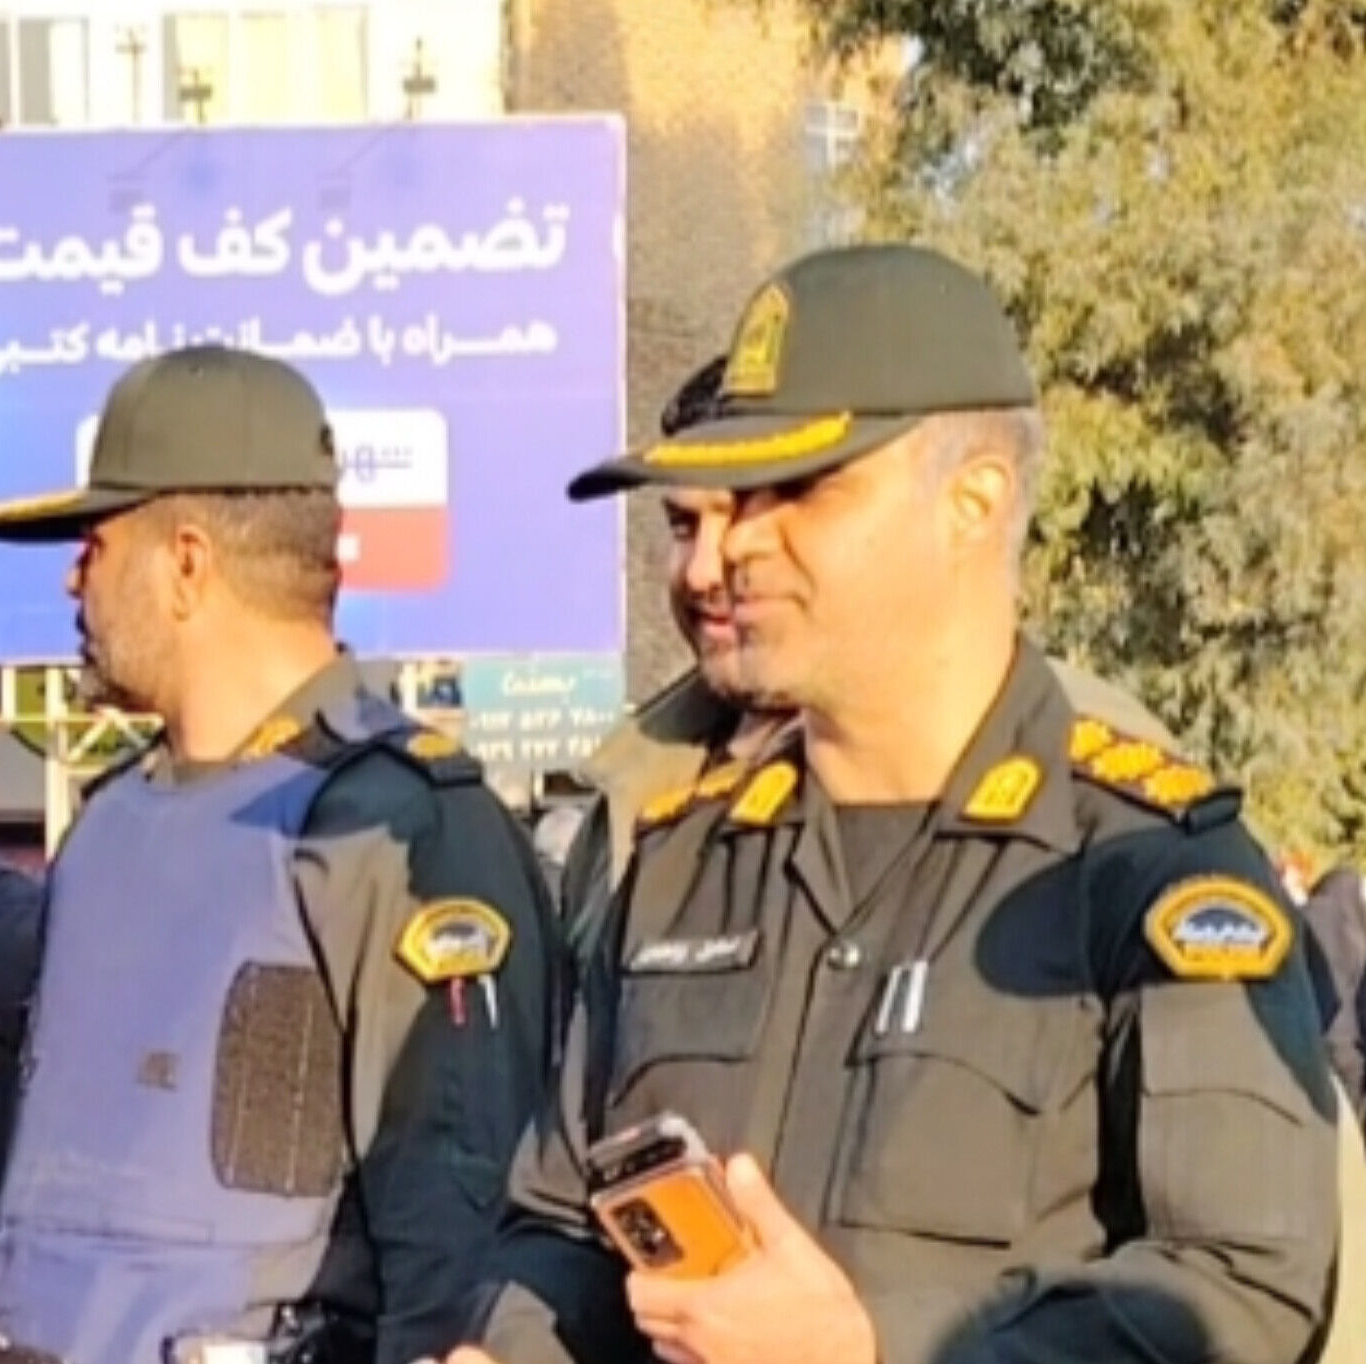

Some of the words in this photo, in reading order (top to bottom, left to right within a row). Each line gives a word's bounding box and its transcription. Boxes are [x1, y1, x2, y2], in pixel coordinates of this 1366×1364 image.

[177, 204, 292, 278] کف
[302, 196, 571, 296] تضمین
[366, 313, 396, 366] با
[402, 312, 558, 367] همراه
